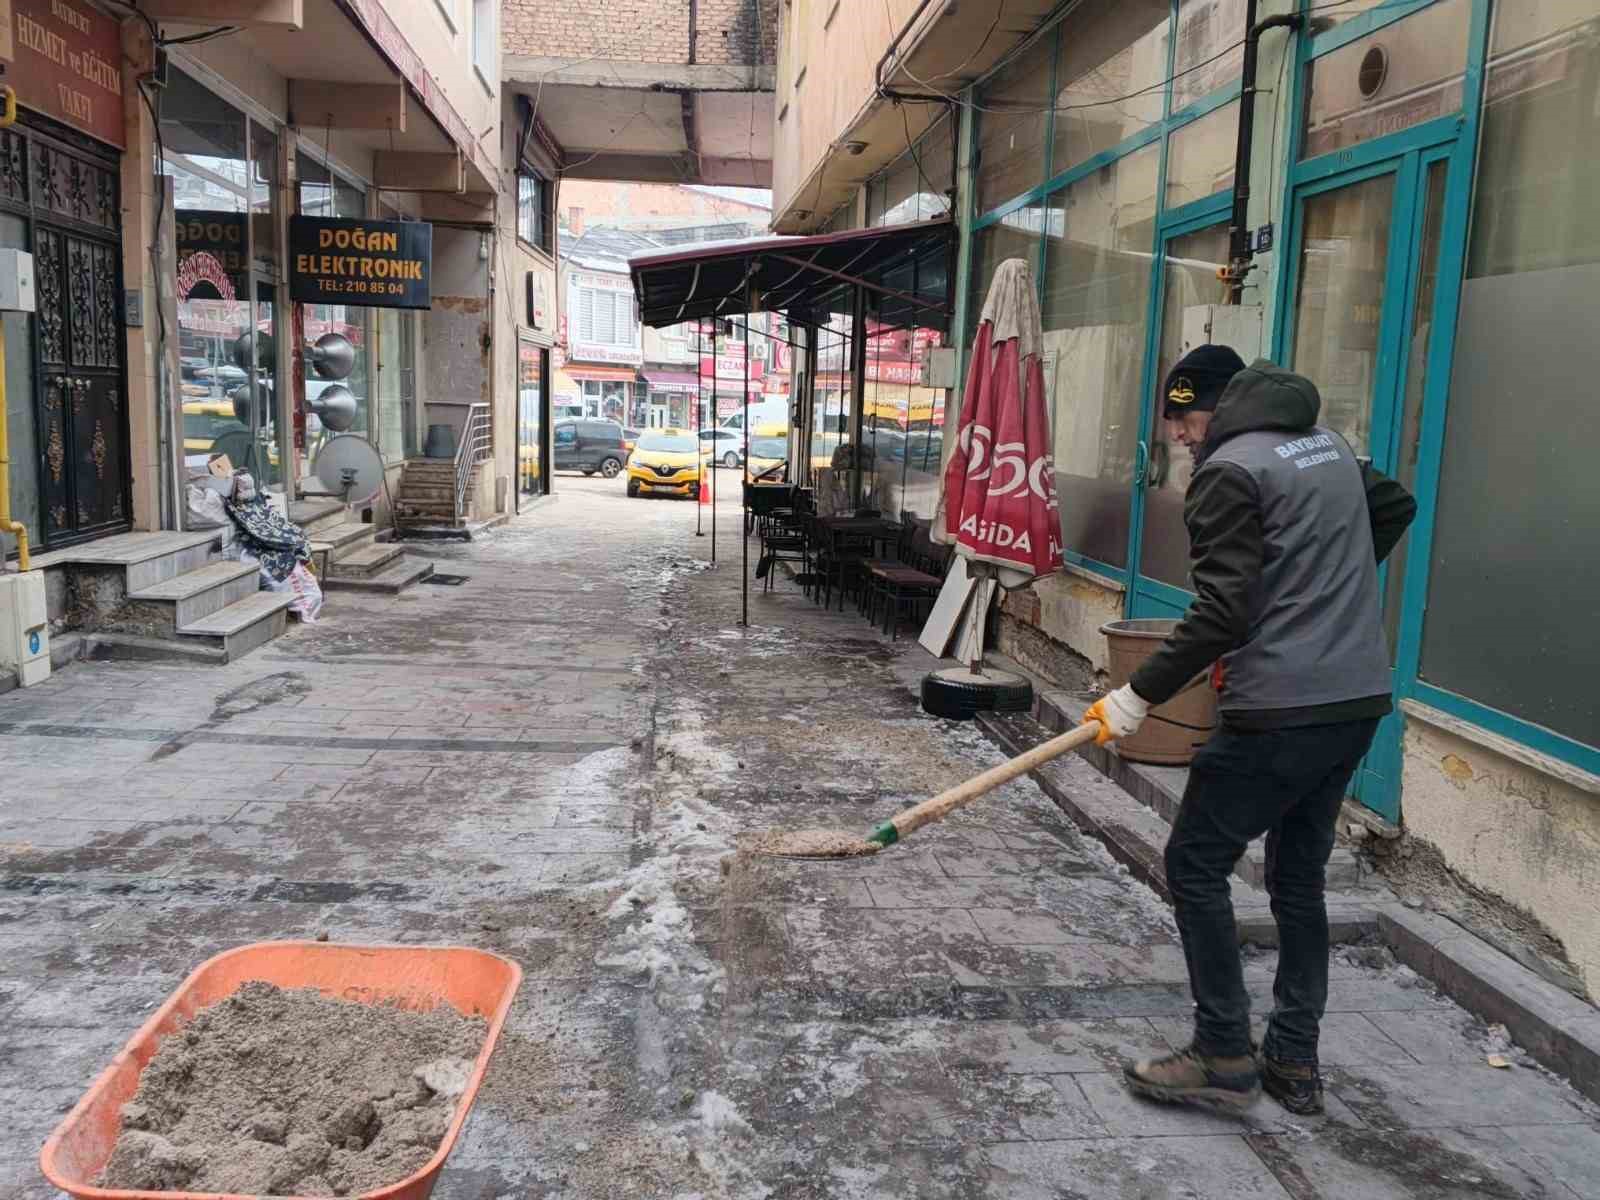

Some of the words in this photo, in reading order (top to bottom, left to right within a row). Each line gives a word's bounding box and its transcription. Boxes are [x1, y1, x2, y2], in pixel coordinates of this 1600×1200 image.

[16, 11, 67, 66] HİZMET
[69, 52, 81, 75] ve
[82, 50, 121, 96] EĞİTİM
[57, 83, 93, 124] VAKFI
[319, 226, 398, 252] DOĞAN
[318, 279, 343, 292] TEL:
[346, 280, 367, 293] 210
[369, 281, 385, 295] 85
[387, 282, 405, 296] 04
